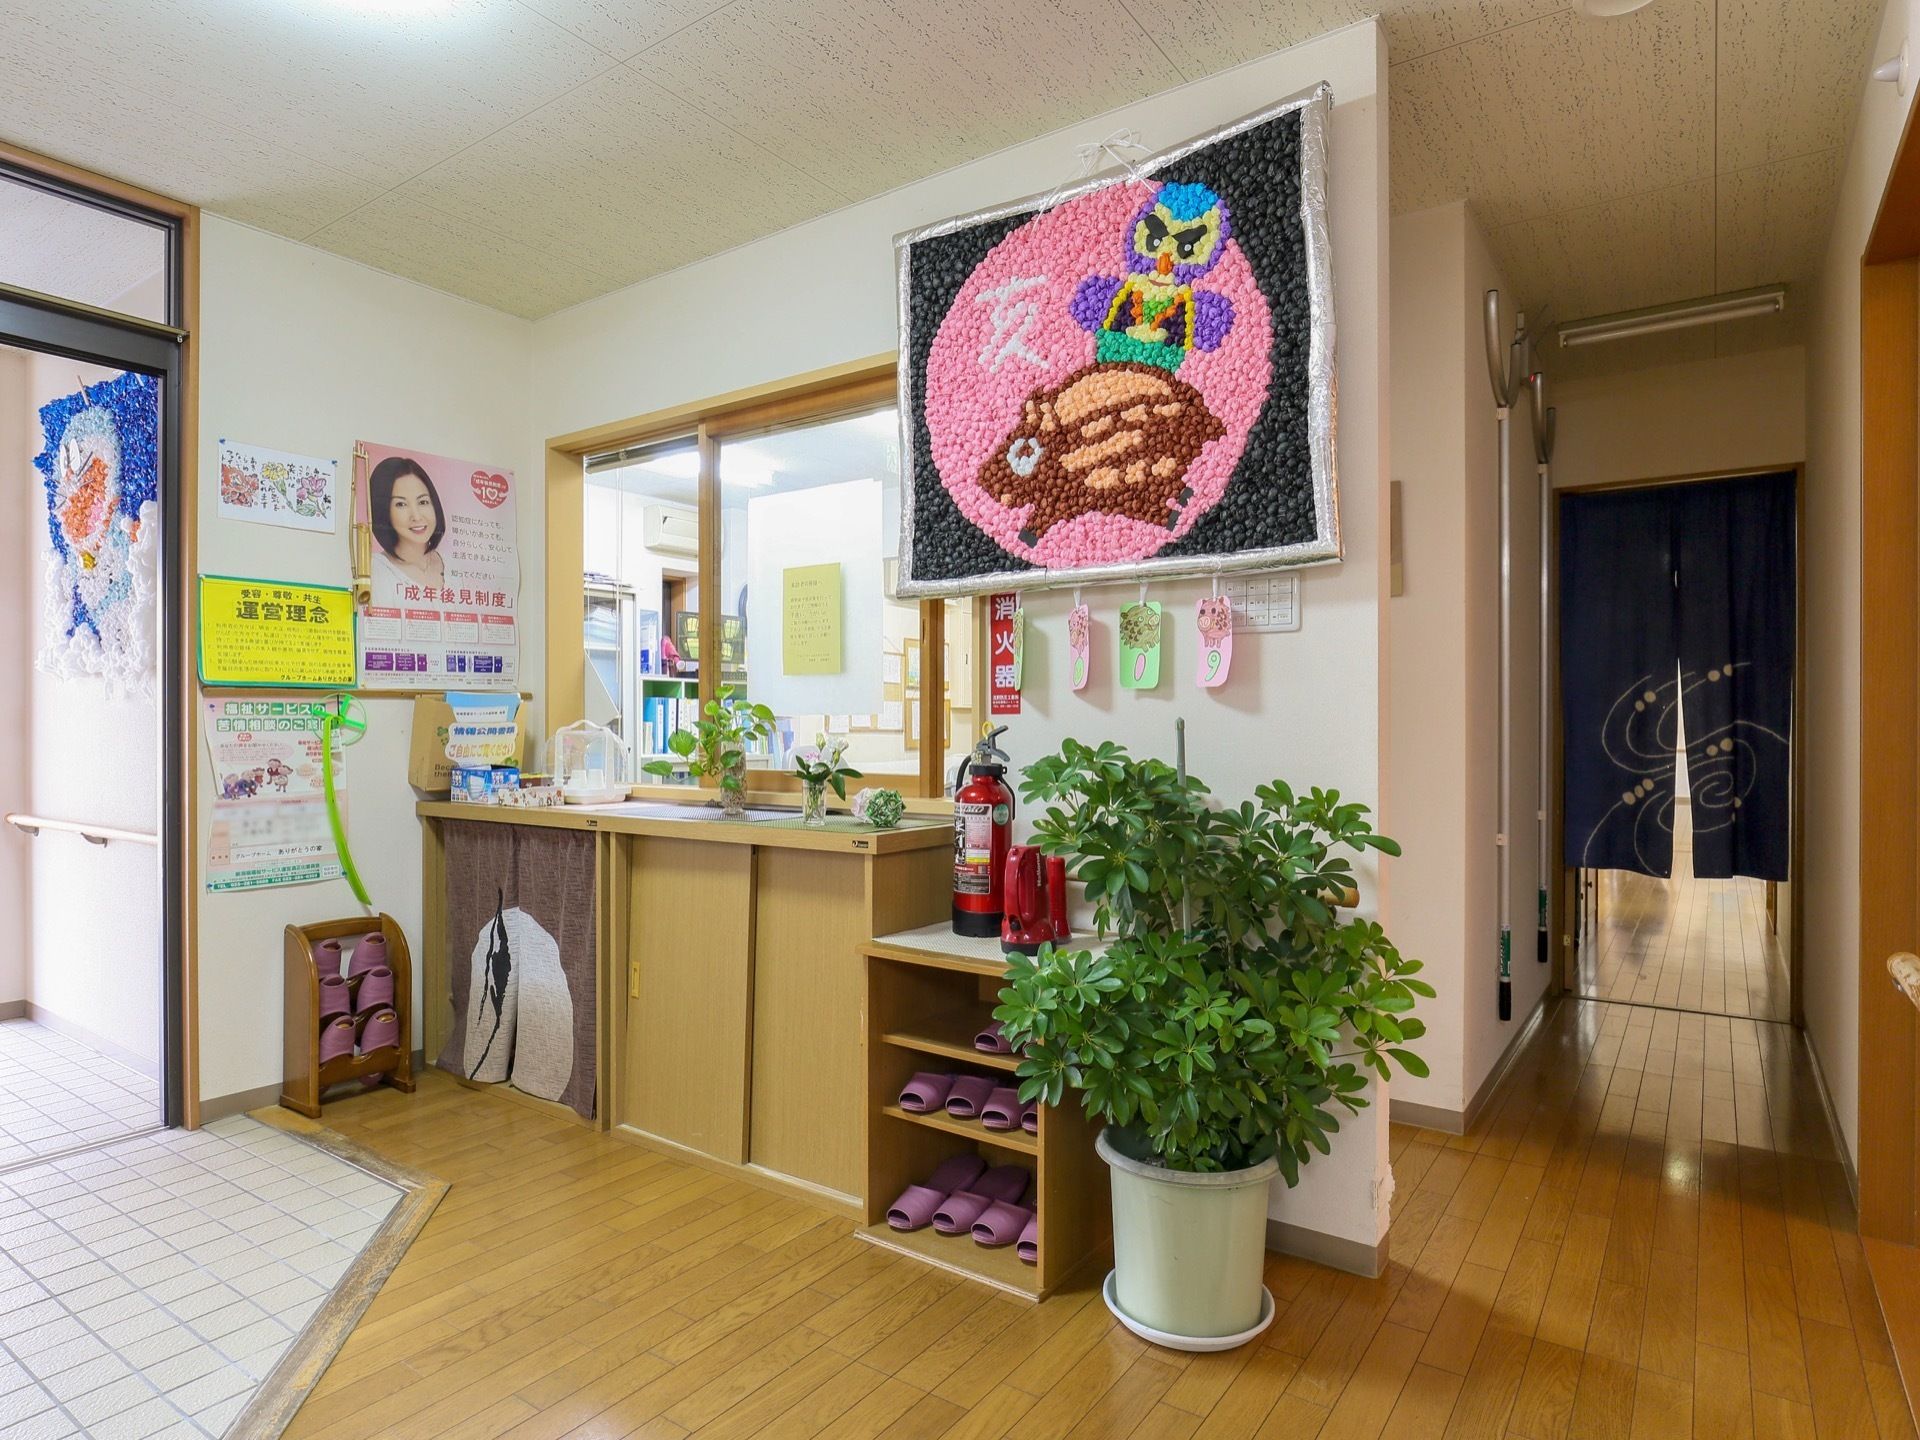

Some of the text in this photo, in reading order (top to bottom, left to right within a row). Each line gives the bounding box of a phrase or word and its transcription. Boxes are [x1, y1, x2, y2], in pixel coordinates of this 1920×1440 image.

[241, 589, 321, 604] 受容・尊敬・共生
[396, 583, 513, 608] 「成年後見制度」
[236, 601, 329, 624] 運営理念
[995, 596, 1015, 688] 消火器
[1205, 650, 1221, 681] 9
[217, 719, 326, 731] 苦情相談のご案
